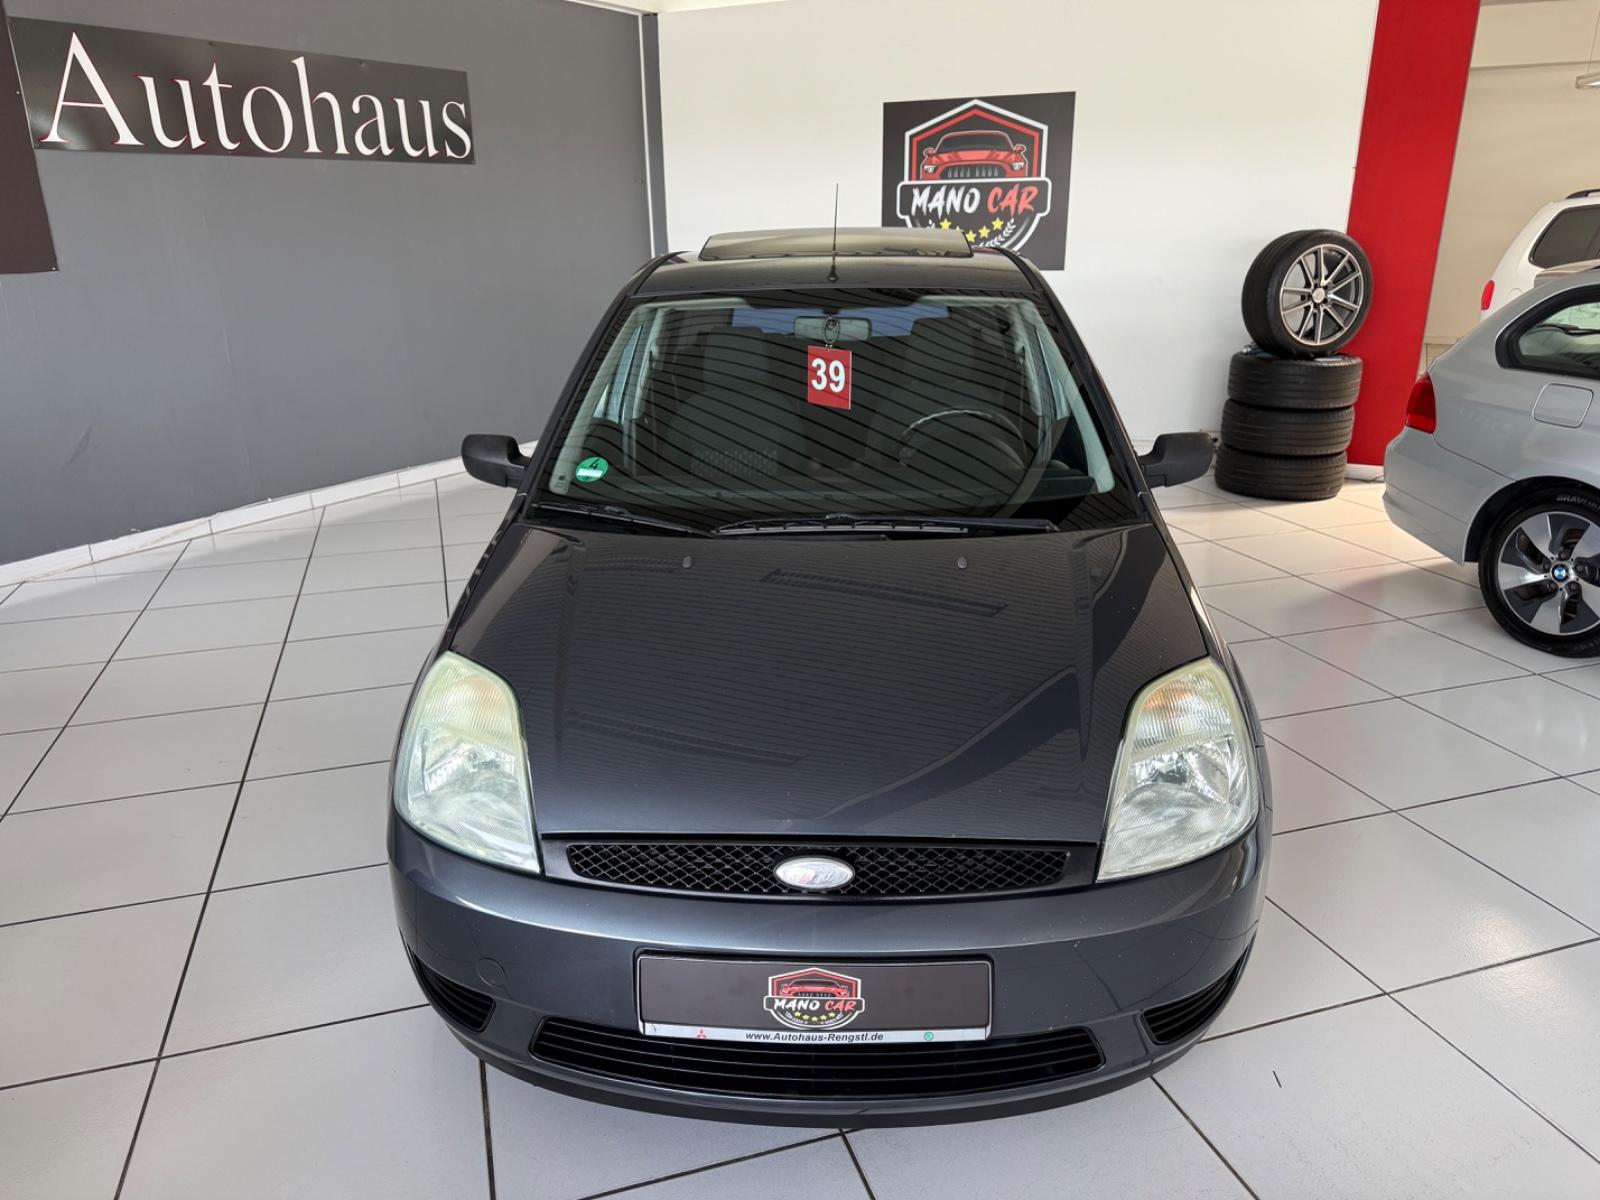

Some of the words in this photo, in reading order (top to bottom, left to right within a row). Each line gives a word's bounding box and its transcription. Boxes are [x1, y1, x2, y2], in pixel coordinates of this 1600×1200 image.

[40, 32, 472, 159] Autohaus
[911, 185, 980, 219] MANO
[987, 183, 1038, 217] CAR
[811, 357, 846, 393] 39
[589, 457, 600, 470] 4
[773, 998, 820, 1011] MANO
[824, 1000, 856, 1012] CAR
[745, 1032, 884, 1042] www.Autohaus-Rengstl.de
